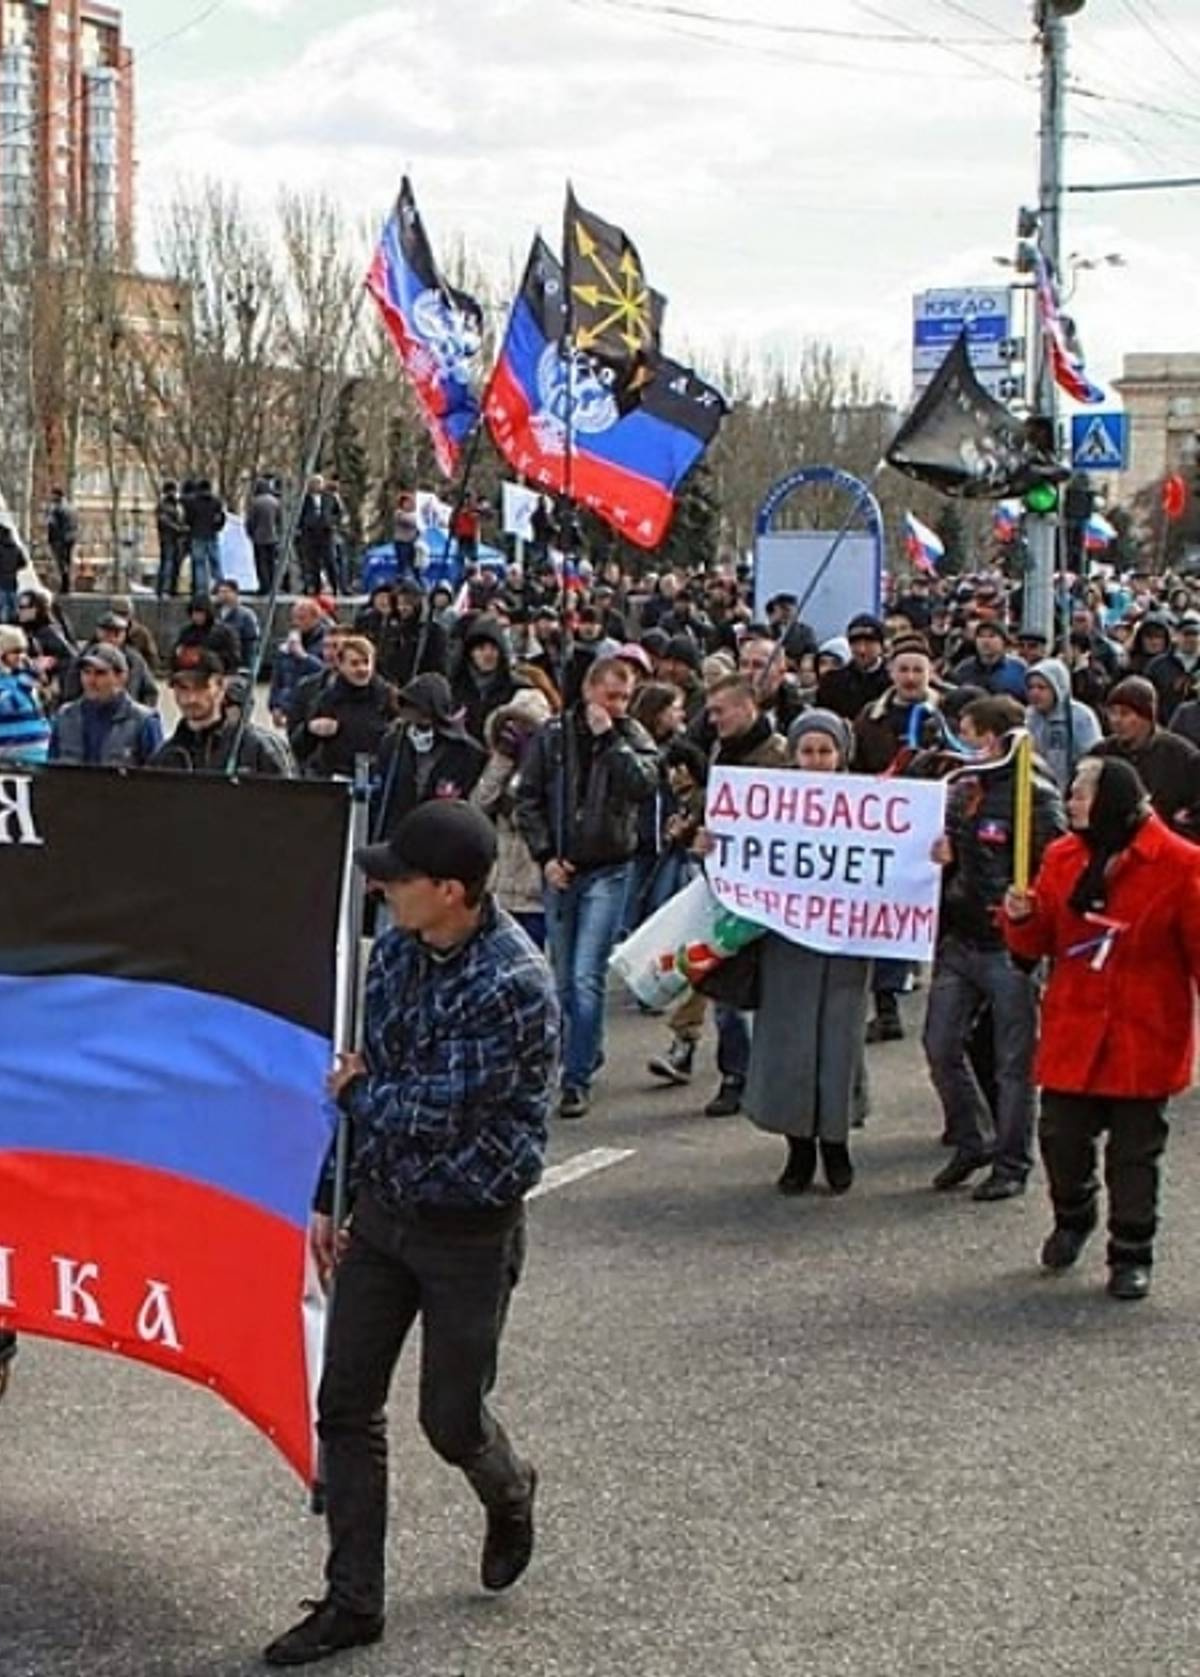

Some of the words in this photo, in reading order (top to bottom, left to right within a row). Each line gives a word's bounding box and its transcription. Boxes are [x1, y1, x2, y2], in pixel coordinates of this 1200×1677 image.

[709, 781, 912, 834] ДОНБАСС
[713, 831, 896, 887] ТРЕБУЕТ
[713, 876, 935, 943] РЕФЕРЕНДУМ
